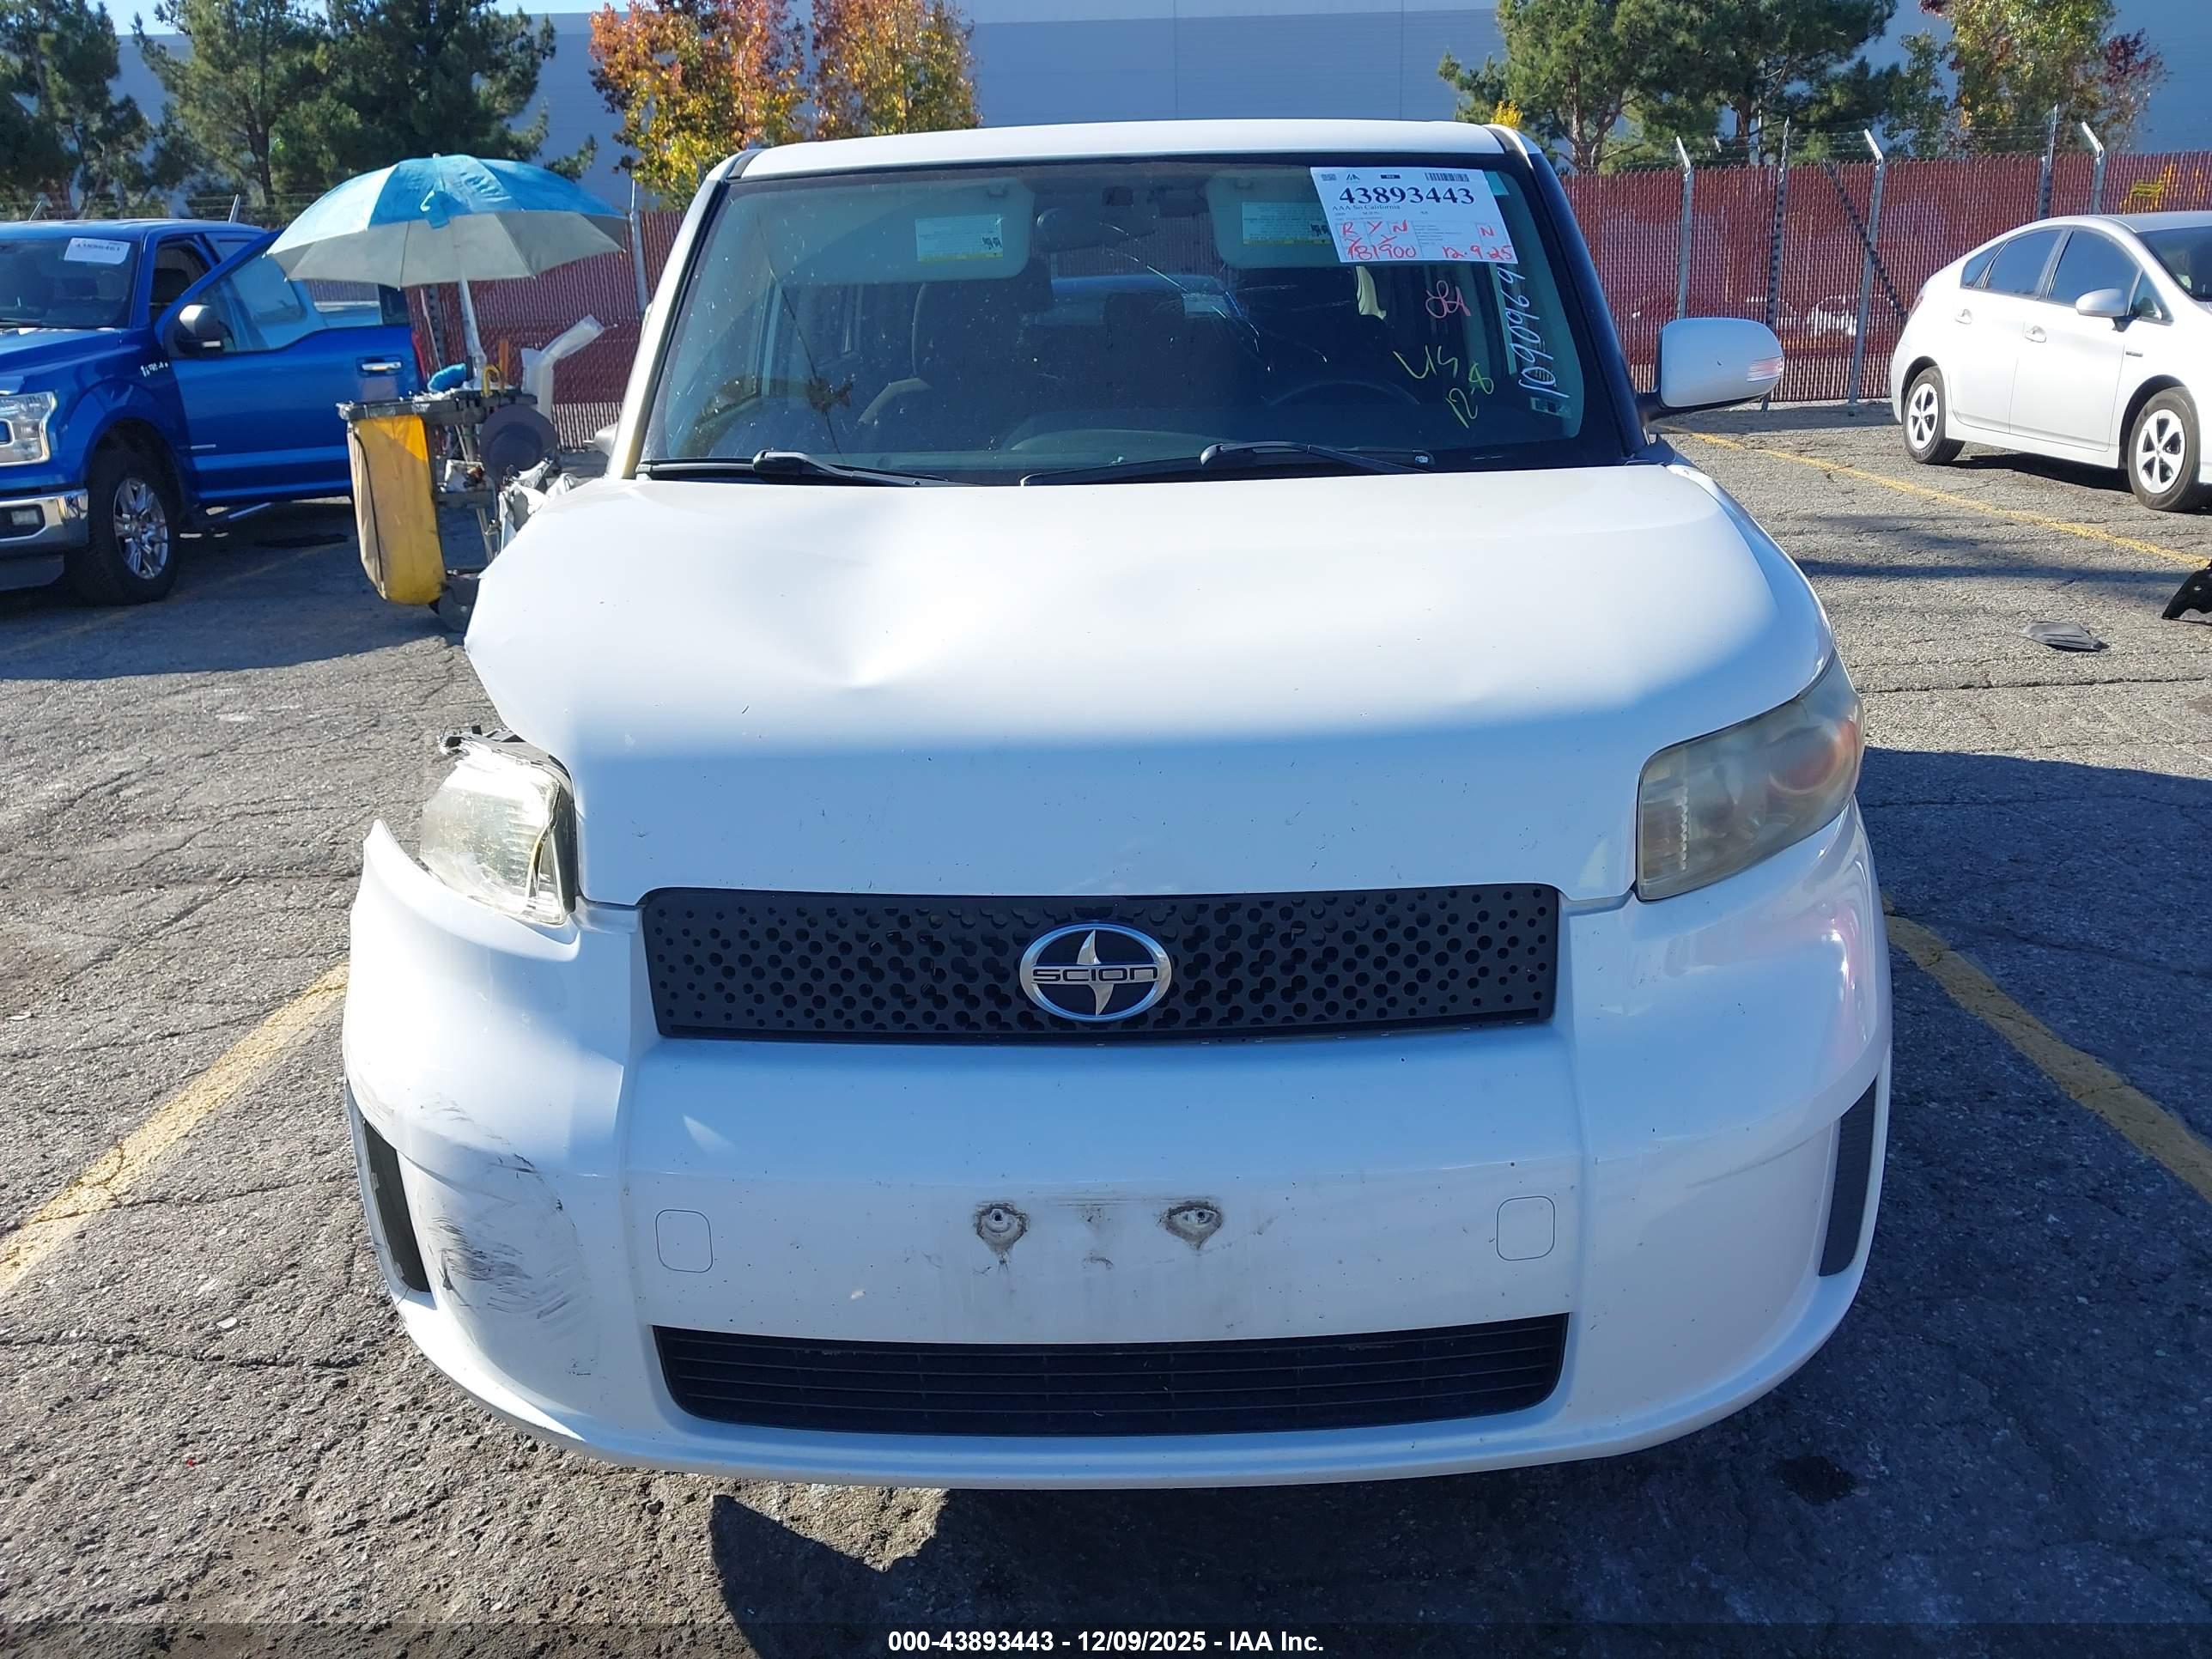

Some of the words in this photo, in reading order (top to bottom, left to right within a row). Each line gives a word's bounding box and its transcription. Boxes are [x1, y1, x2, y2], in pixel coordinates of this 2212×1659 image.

[1340, 185, 1475, 205] 43893443
[1342, 221, 1358, 237] R
[1366, 221, 1383, 235] Y
[1392, 219, 1408, 233] N
[1480, 225, 1495, 236] N
[1033, 967, 1158, 982] SCION
